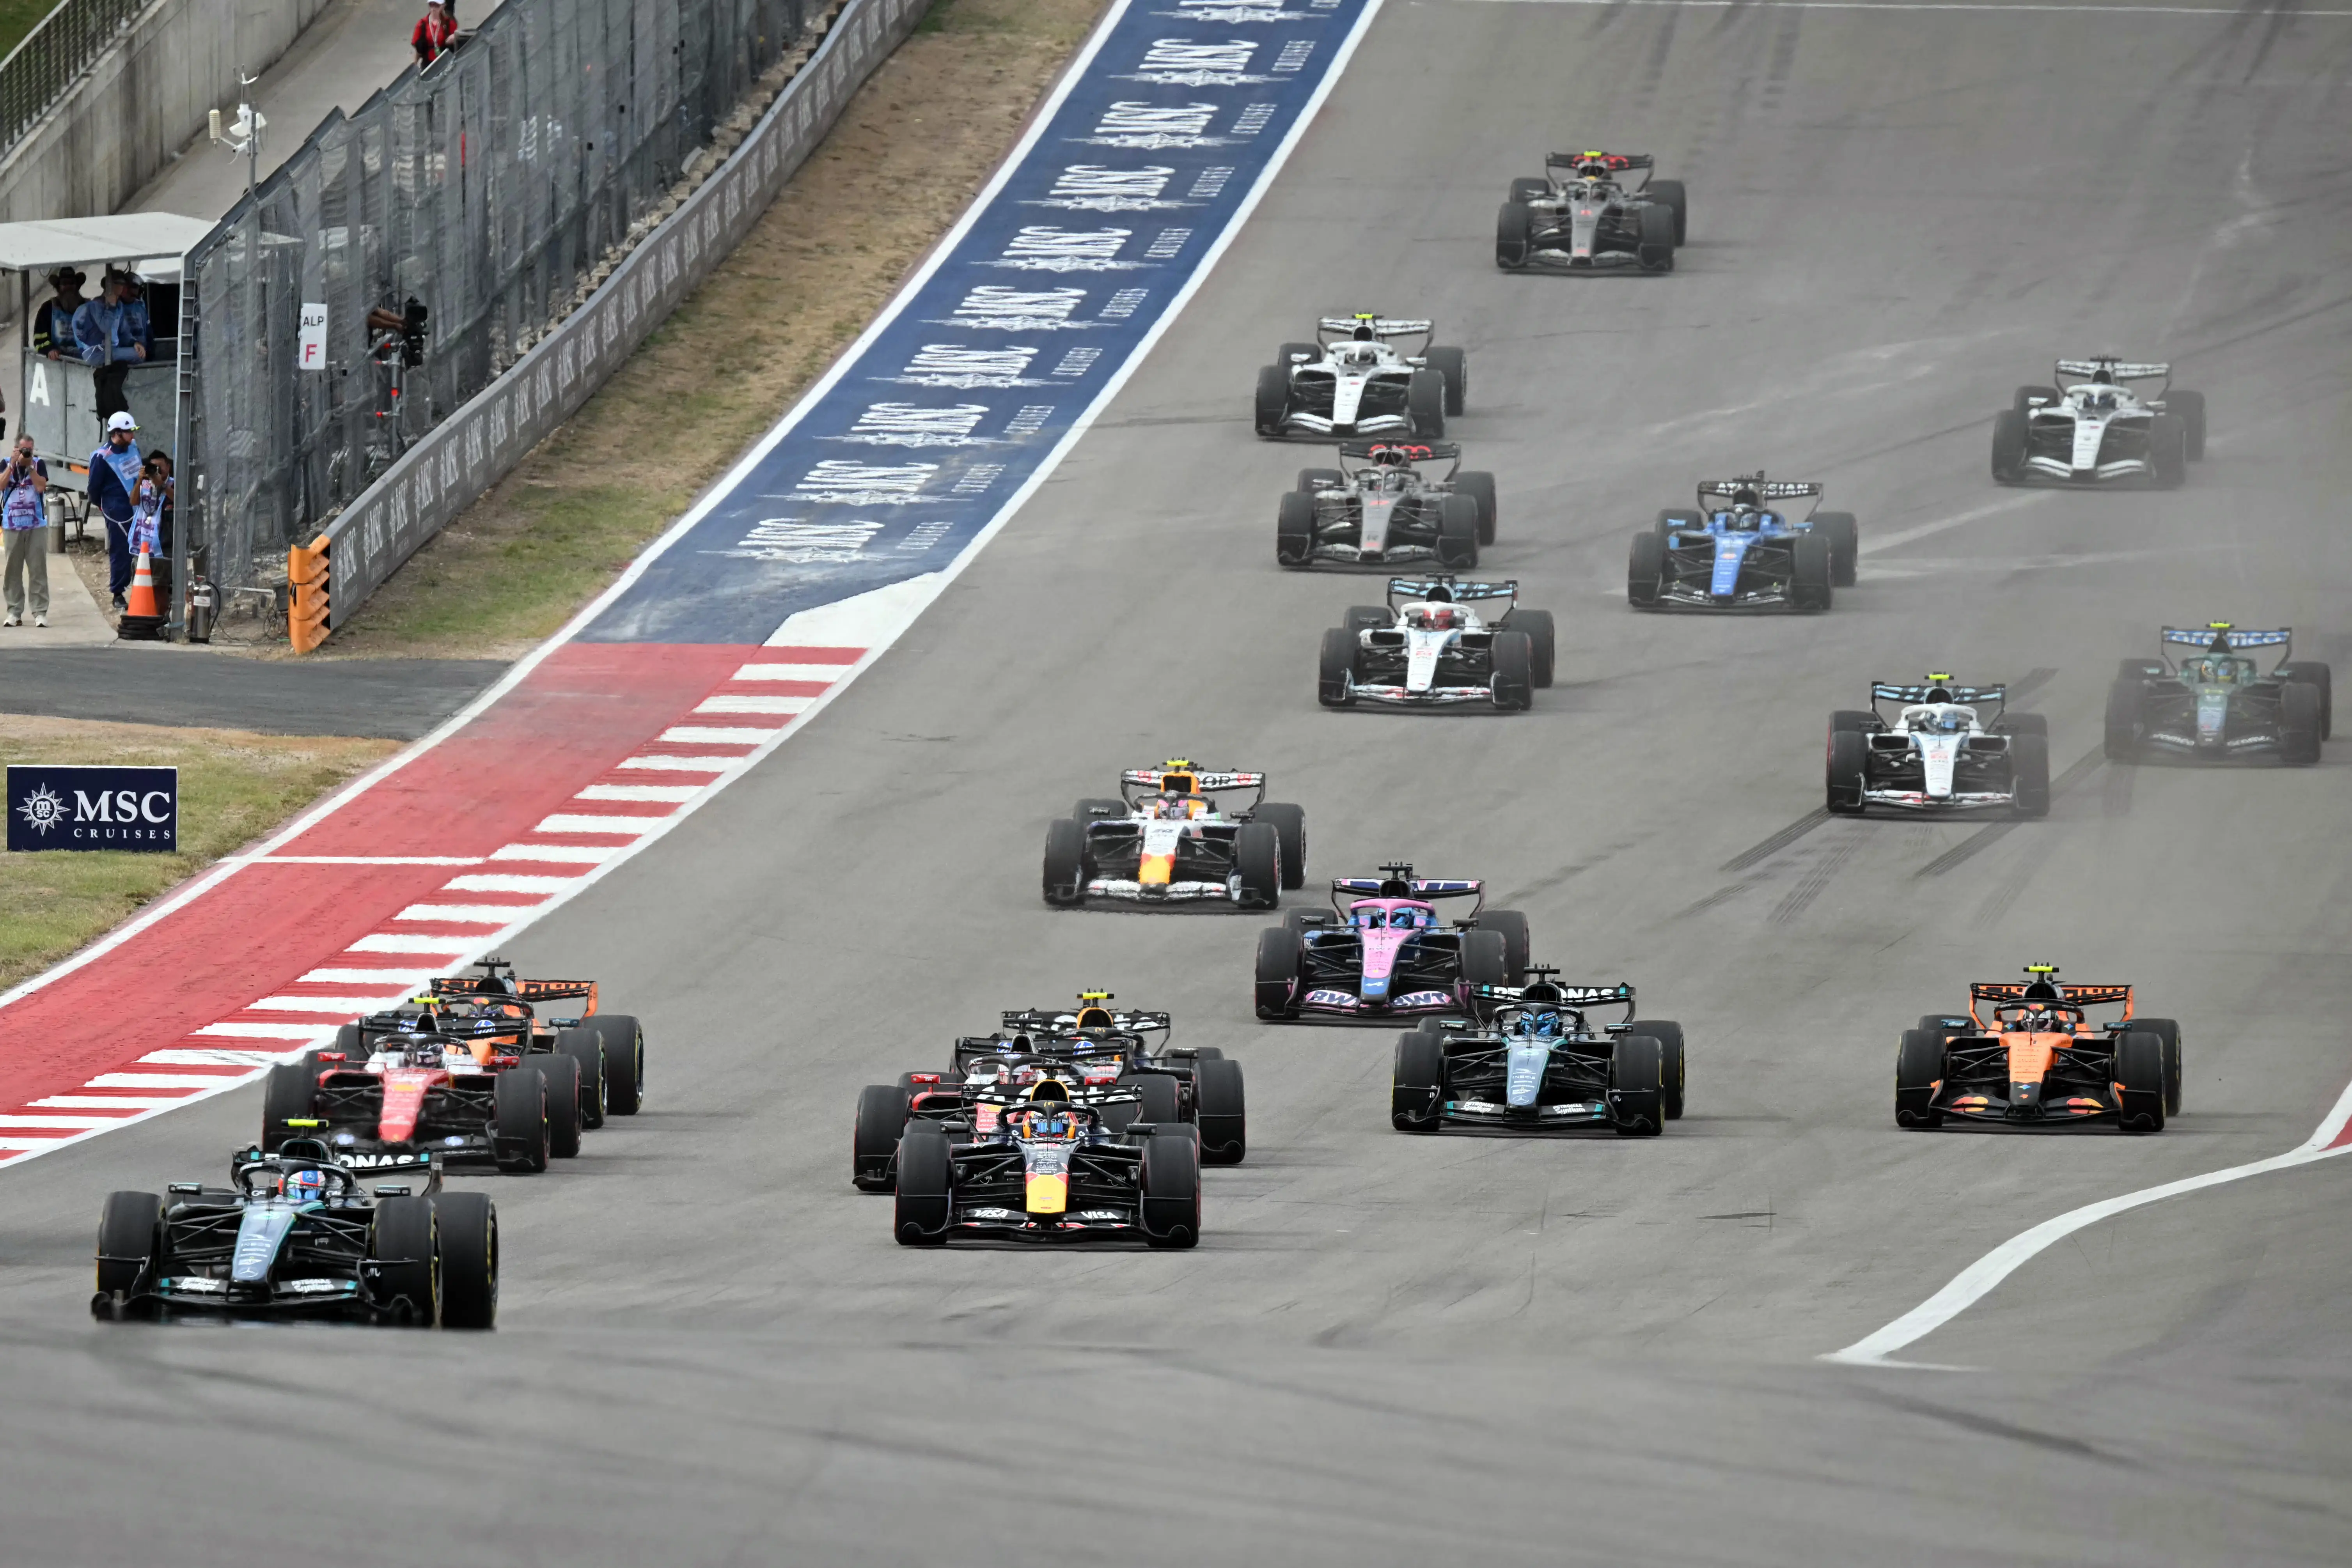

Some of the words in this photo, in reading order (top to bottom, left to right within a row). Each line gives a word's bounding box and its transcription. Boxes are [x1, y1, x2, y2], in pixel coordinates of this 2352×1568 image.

[303, 315, 324, 326] ALP
[305, 344, 317, 363] F
[30, 362, 50, 406] A
[1716, 482, 1808, 495] ATSIAN
[73, 790, 170, 823] MSC
[74, 828, 170, 839] CRUISES
